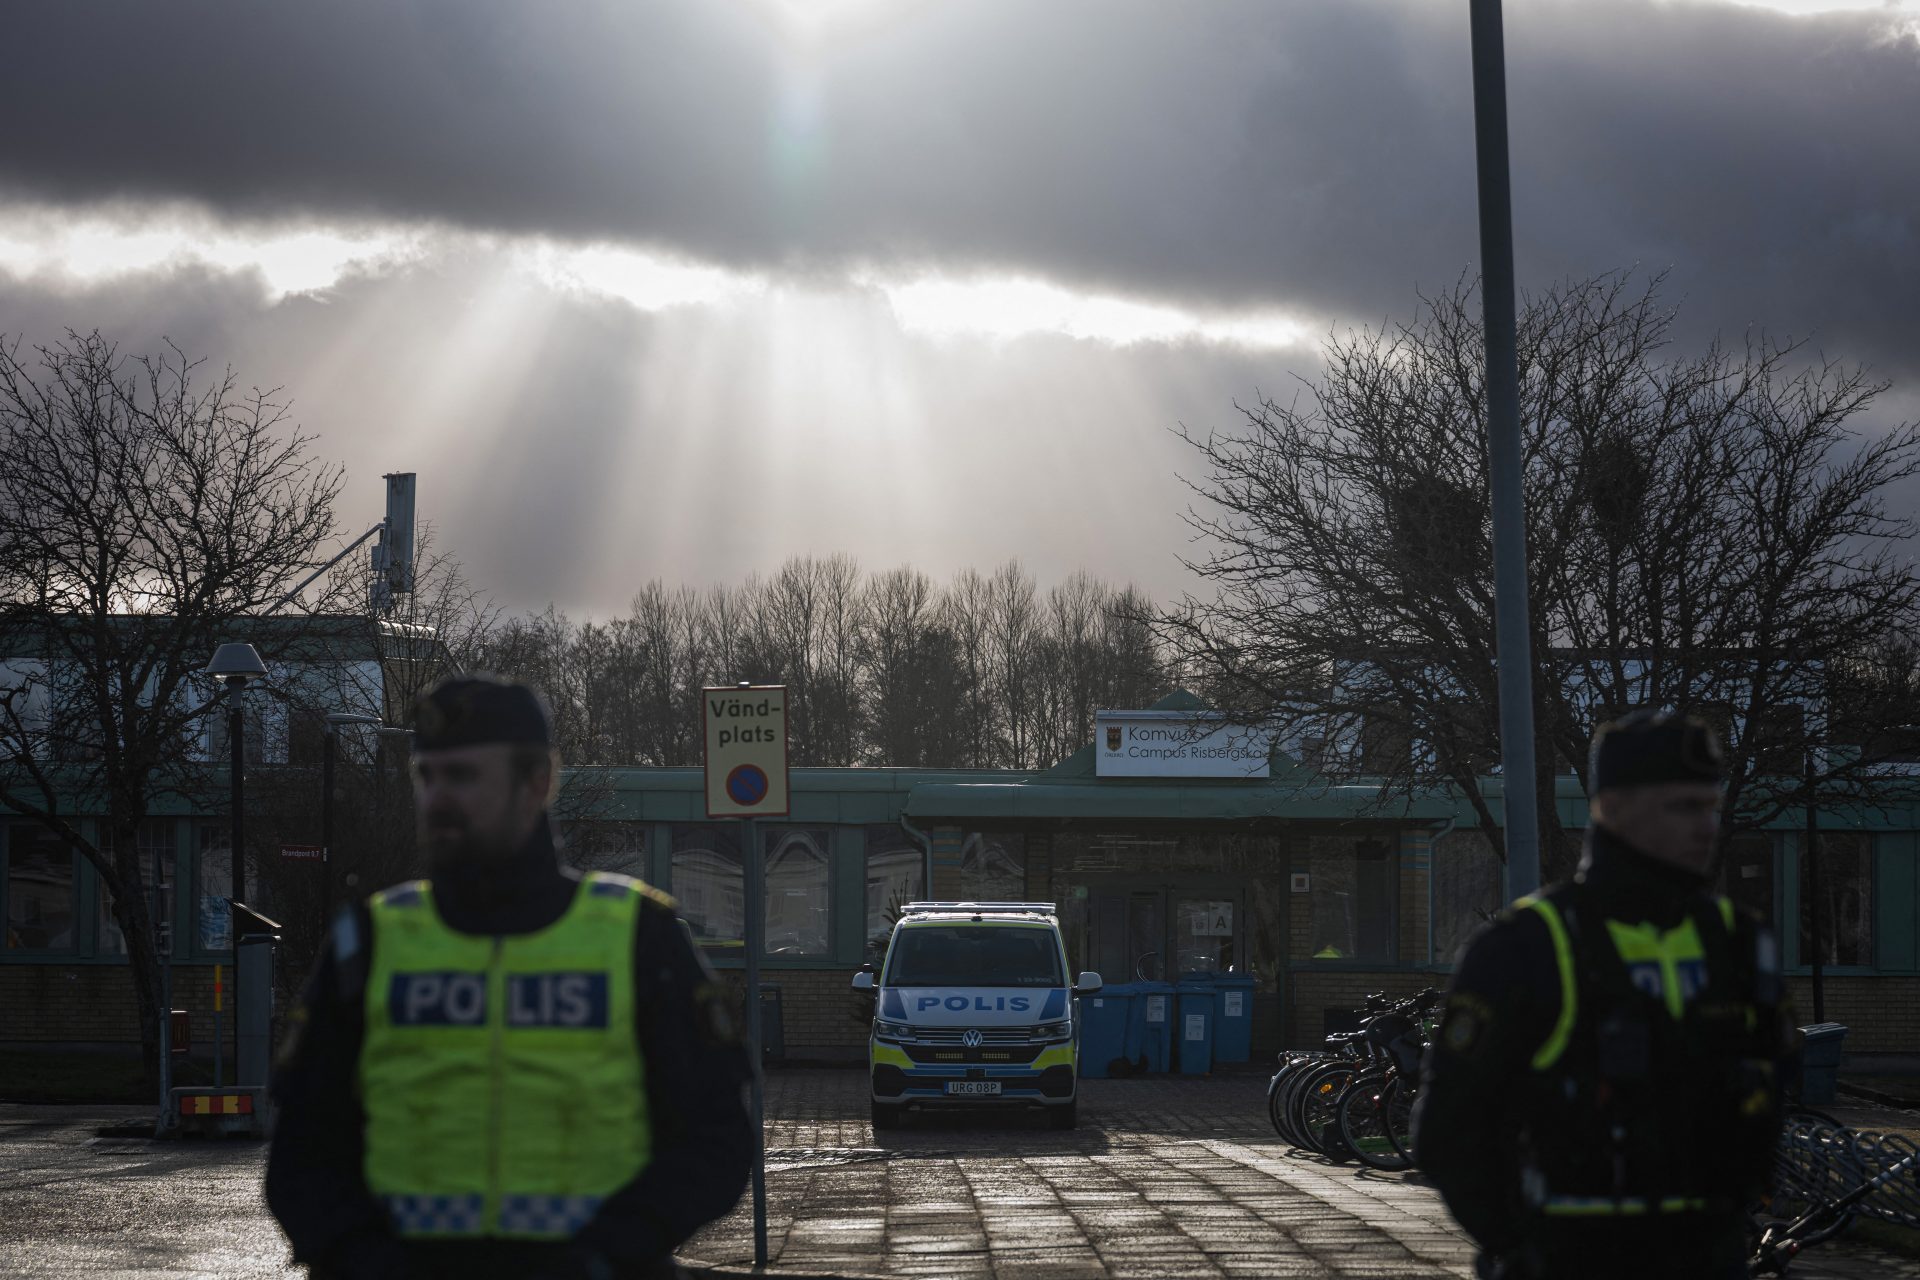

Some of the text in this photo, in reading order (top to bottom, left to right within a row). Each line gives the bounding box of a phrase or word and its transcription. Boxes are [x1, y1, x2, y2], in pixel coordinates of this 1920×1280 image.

[710, 699, 781, 717] Vänd-
[719, 725, 775, 747] plats
[1129, 726, 1196, 741] Komvux
[1128, 746, 1186, 760] Campus
[1191, 746, 1262, 761] Risbergska
[1215, 916, 1226, 928] A
[918, 997, 1030, 1011] POLIS
[952, 1083, 997, 1093] URG 08P
